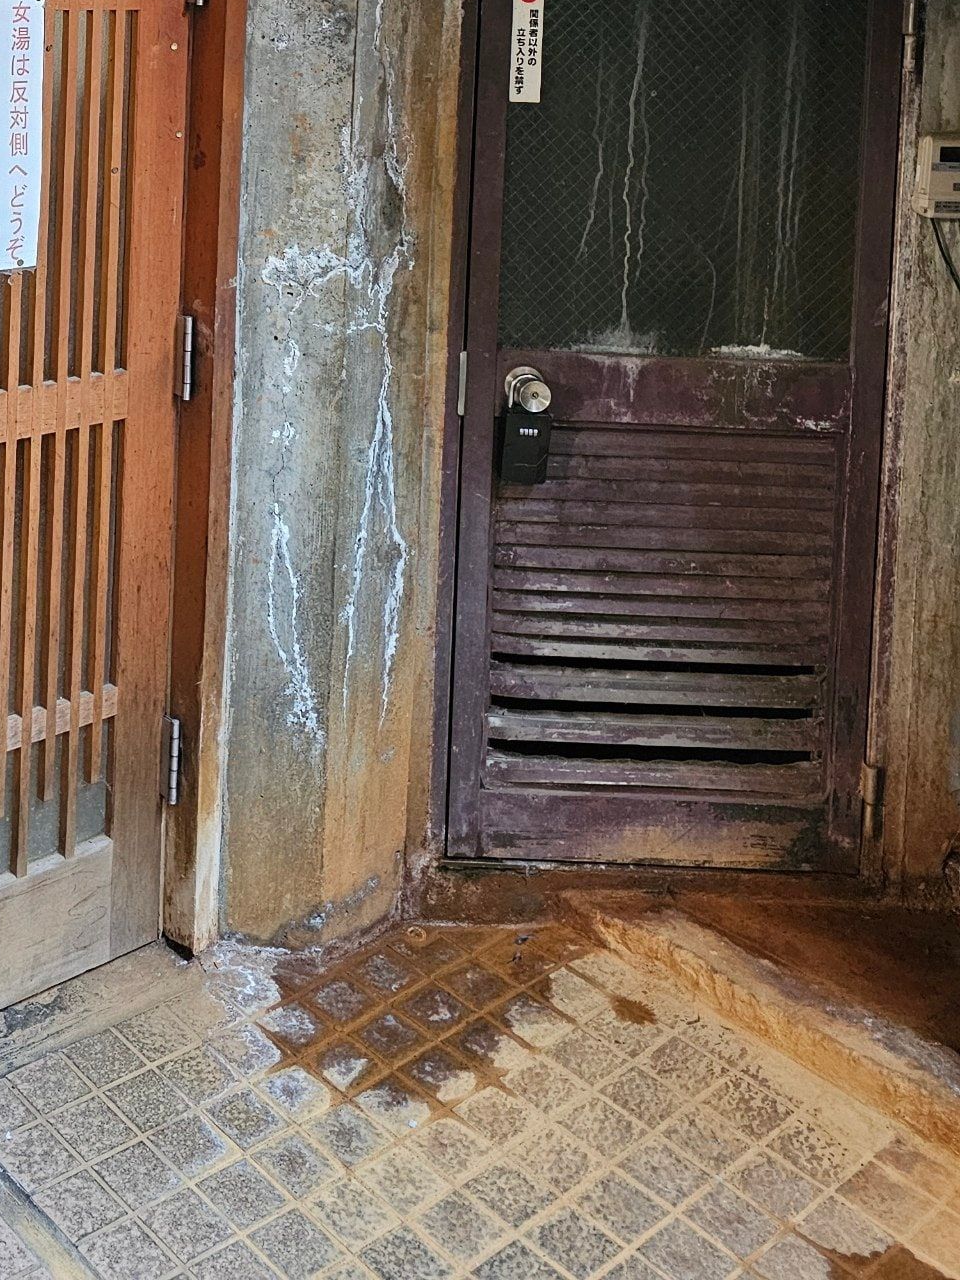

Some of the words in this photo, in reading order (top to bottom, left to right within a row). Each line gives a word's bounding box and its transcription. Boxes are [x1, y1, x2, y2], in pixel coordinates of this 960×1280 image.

[528, 10, 539, 66] 関係者以外の
[6, 1, 32, 261] 女湯は反対側へどうぞ
